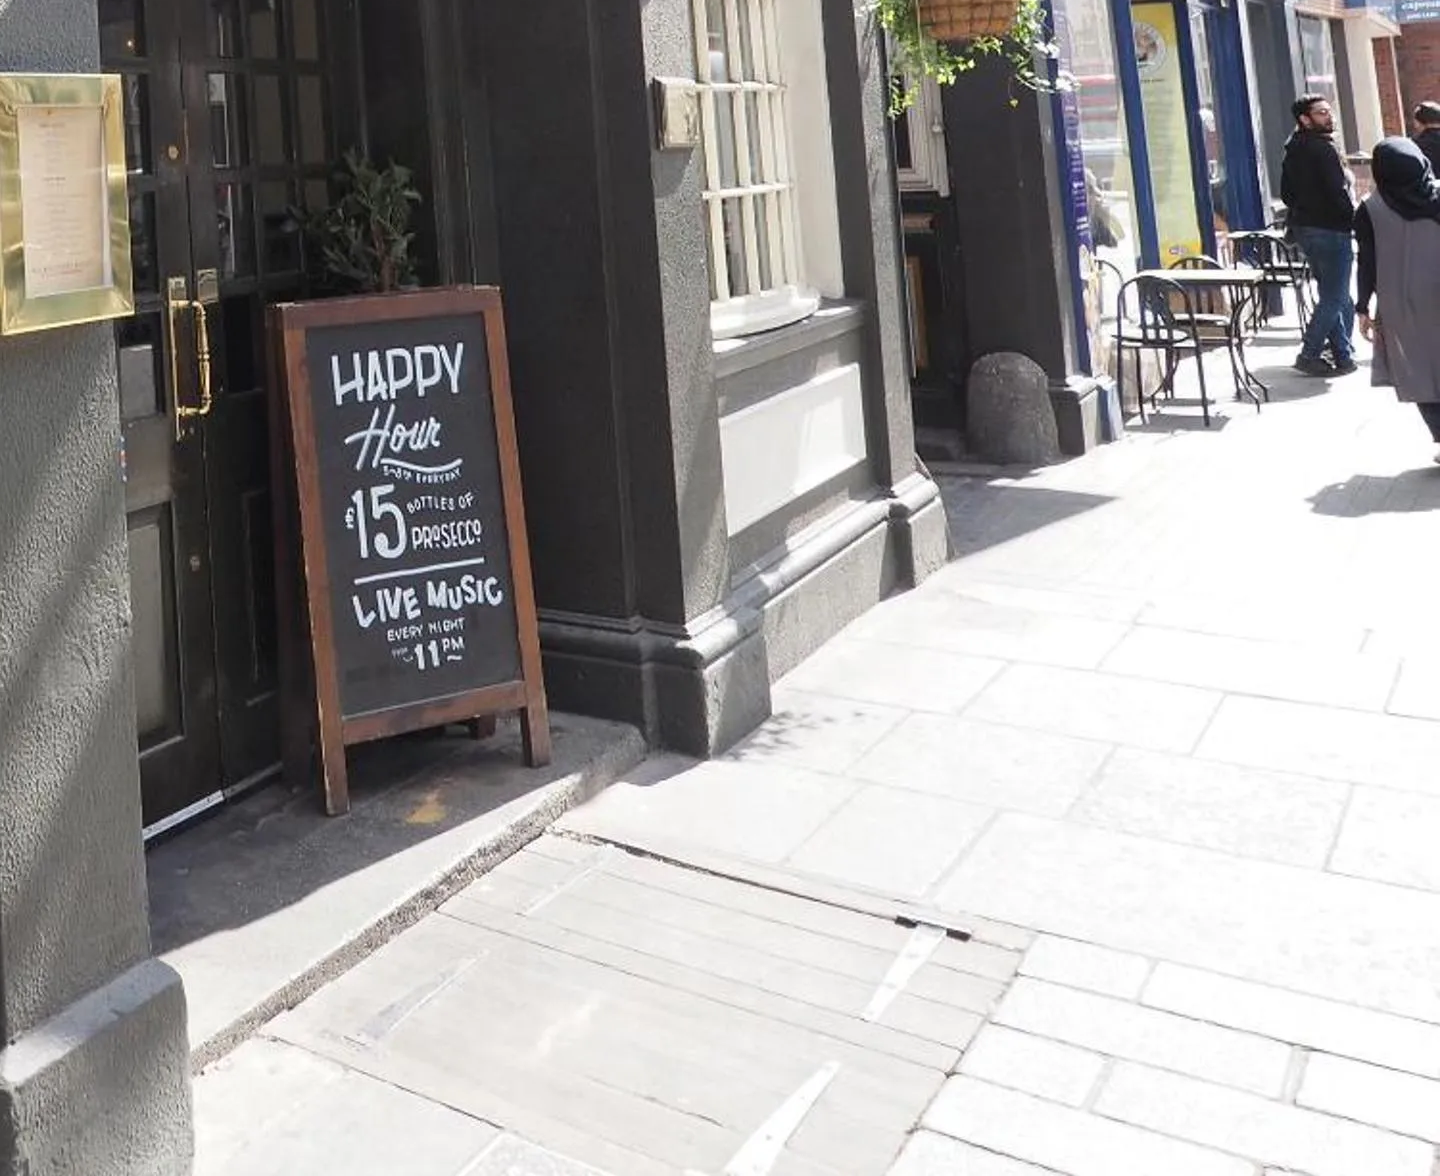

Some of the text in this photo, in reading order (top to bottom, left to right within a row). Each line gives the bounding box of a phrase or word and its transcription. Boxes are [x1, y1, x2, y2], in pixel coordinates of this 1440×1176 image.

[331, 342, 464, 406] HAPPY
[344, 403, 441, 472] Hour
[406, 491, 474, 514] BOTTLES OF
[411, 519, 482, 551] PROSECCO
[351, 574, 504, 628] LIVE MUSIC
[387, 617, 466, 642] EVERY NIGHT
